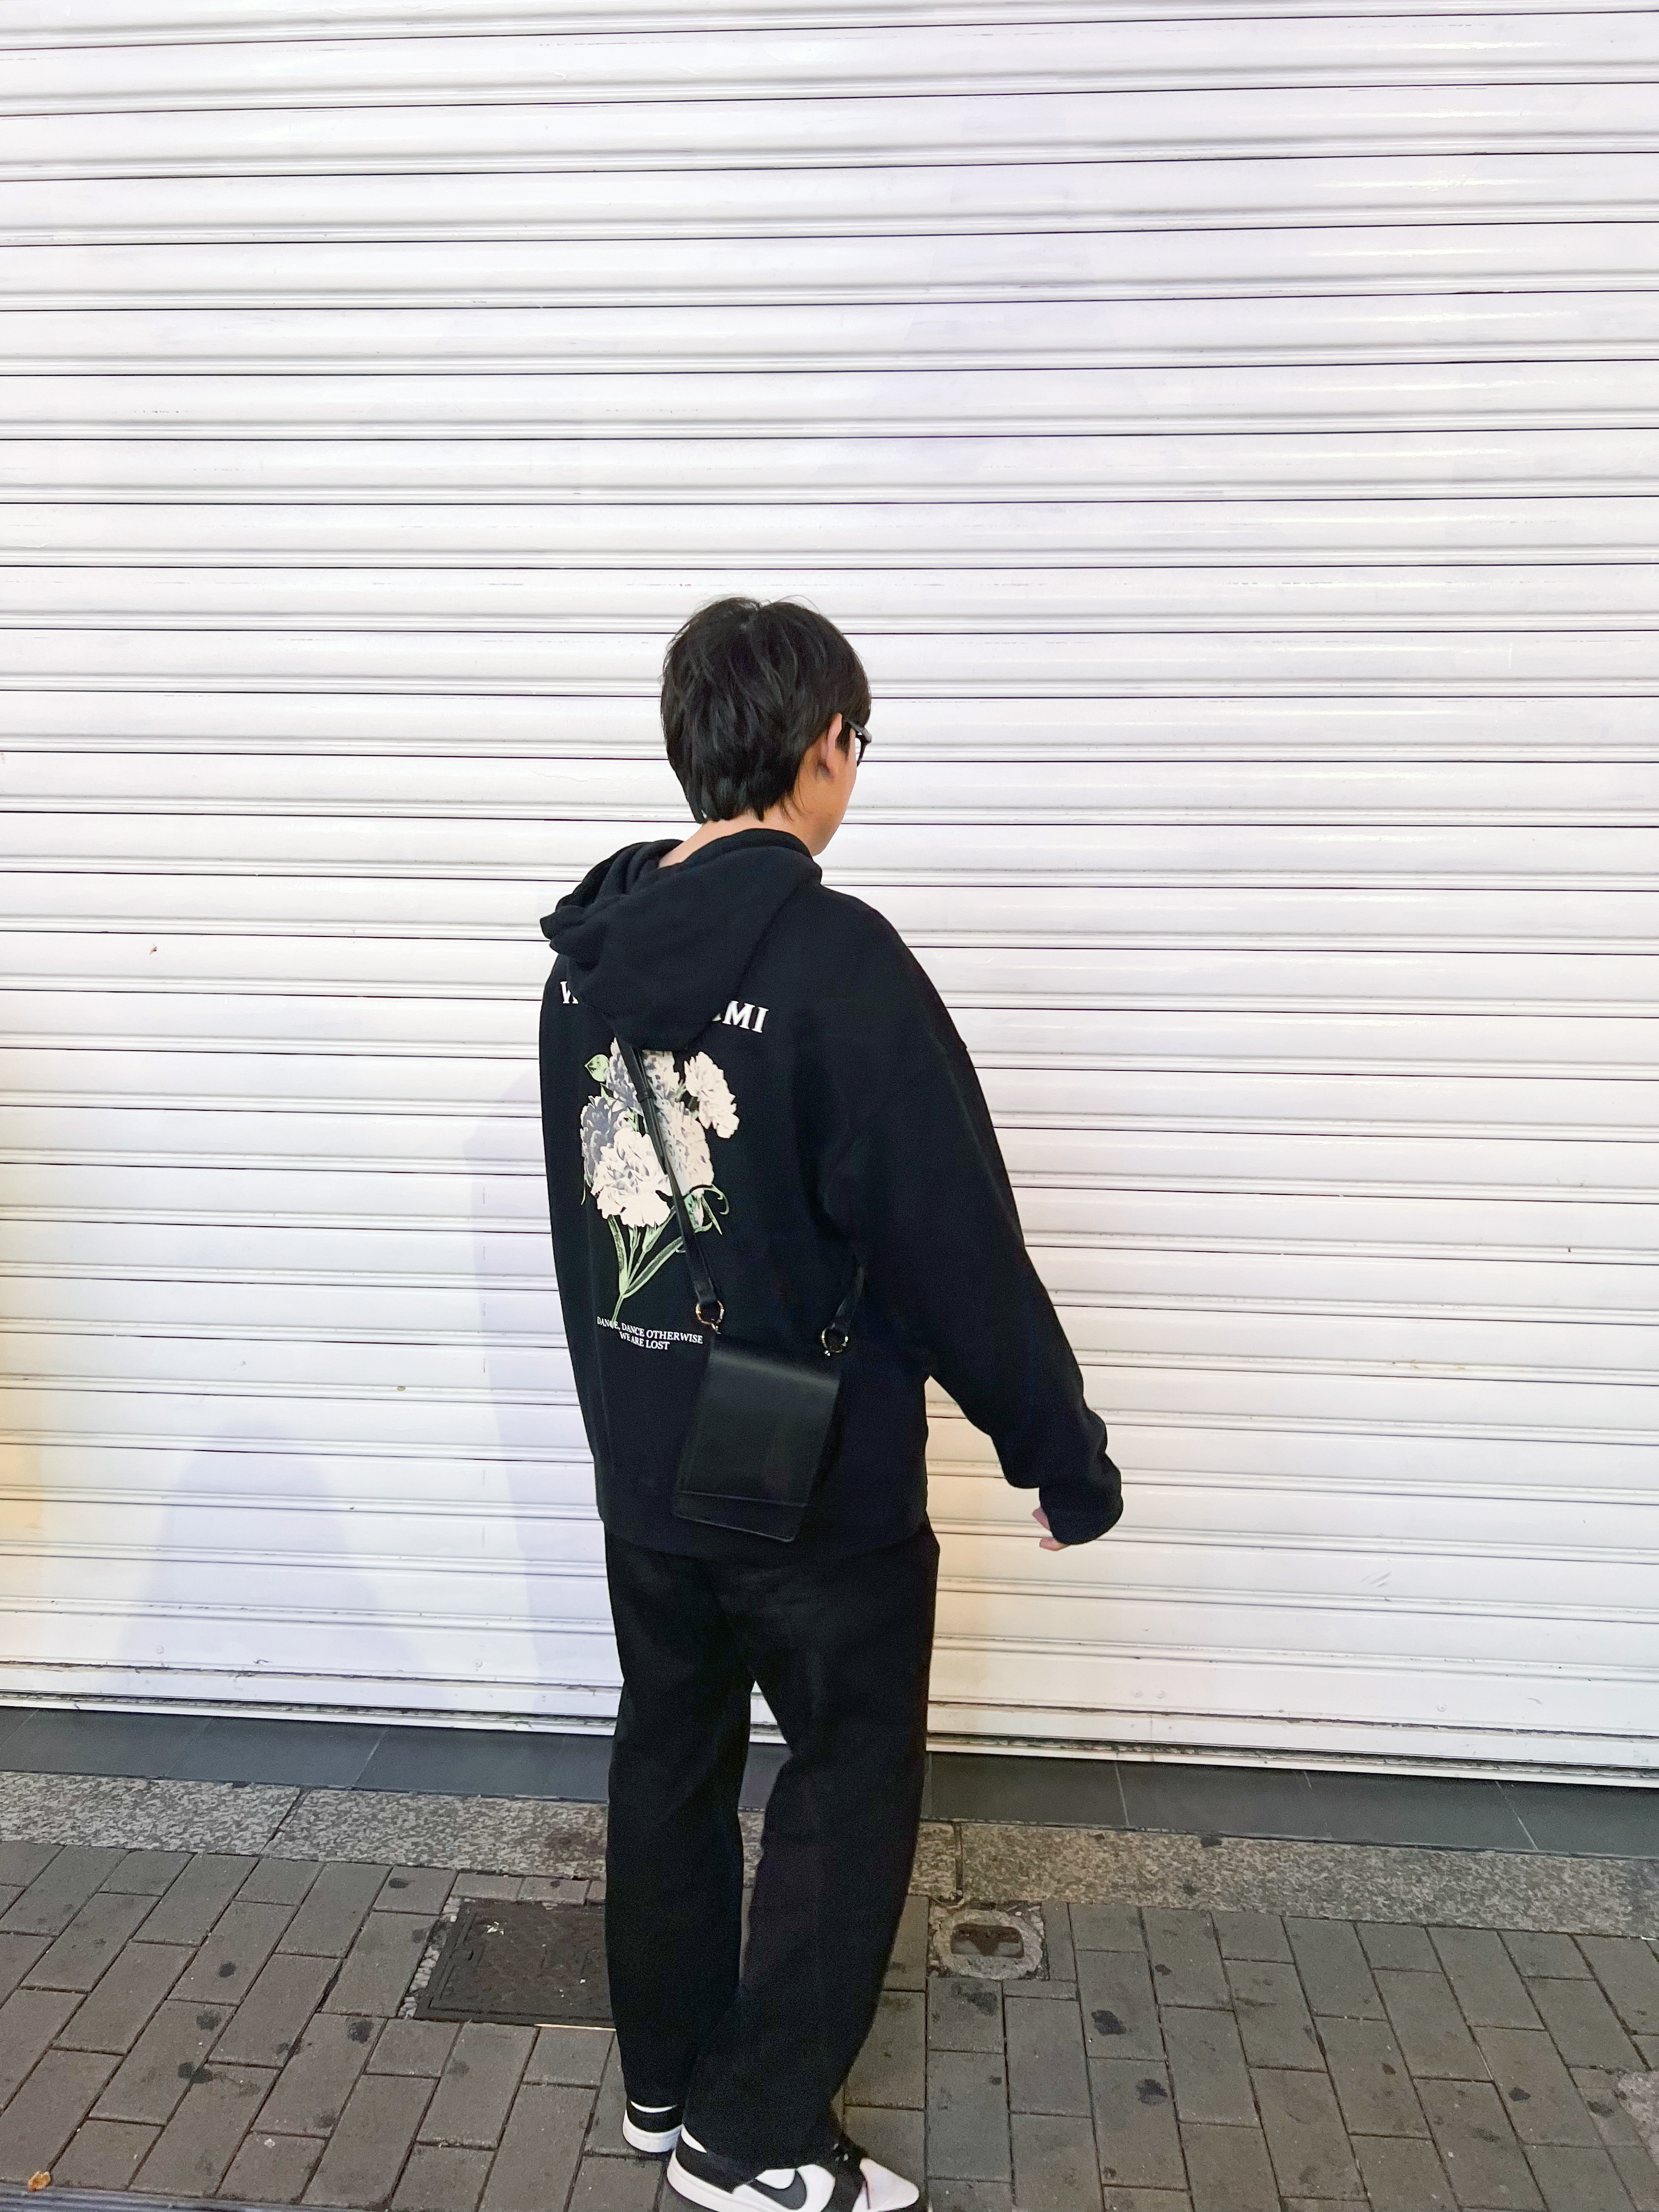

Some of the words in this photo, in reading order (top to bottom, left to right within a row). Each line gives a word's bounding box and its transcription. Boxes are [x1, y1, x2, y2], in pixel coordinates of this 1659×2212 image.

[619, 1331, 630, 1341] WE
[630, 1335, 645, 1347] ARE
[646, 1339, 670, 1350] LOST
[621, 1322, 645, 1337] DANCE
[646, 1329, 703, 1344] OTHERWISE
